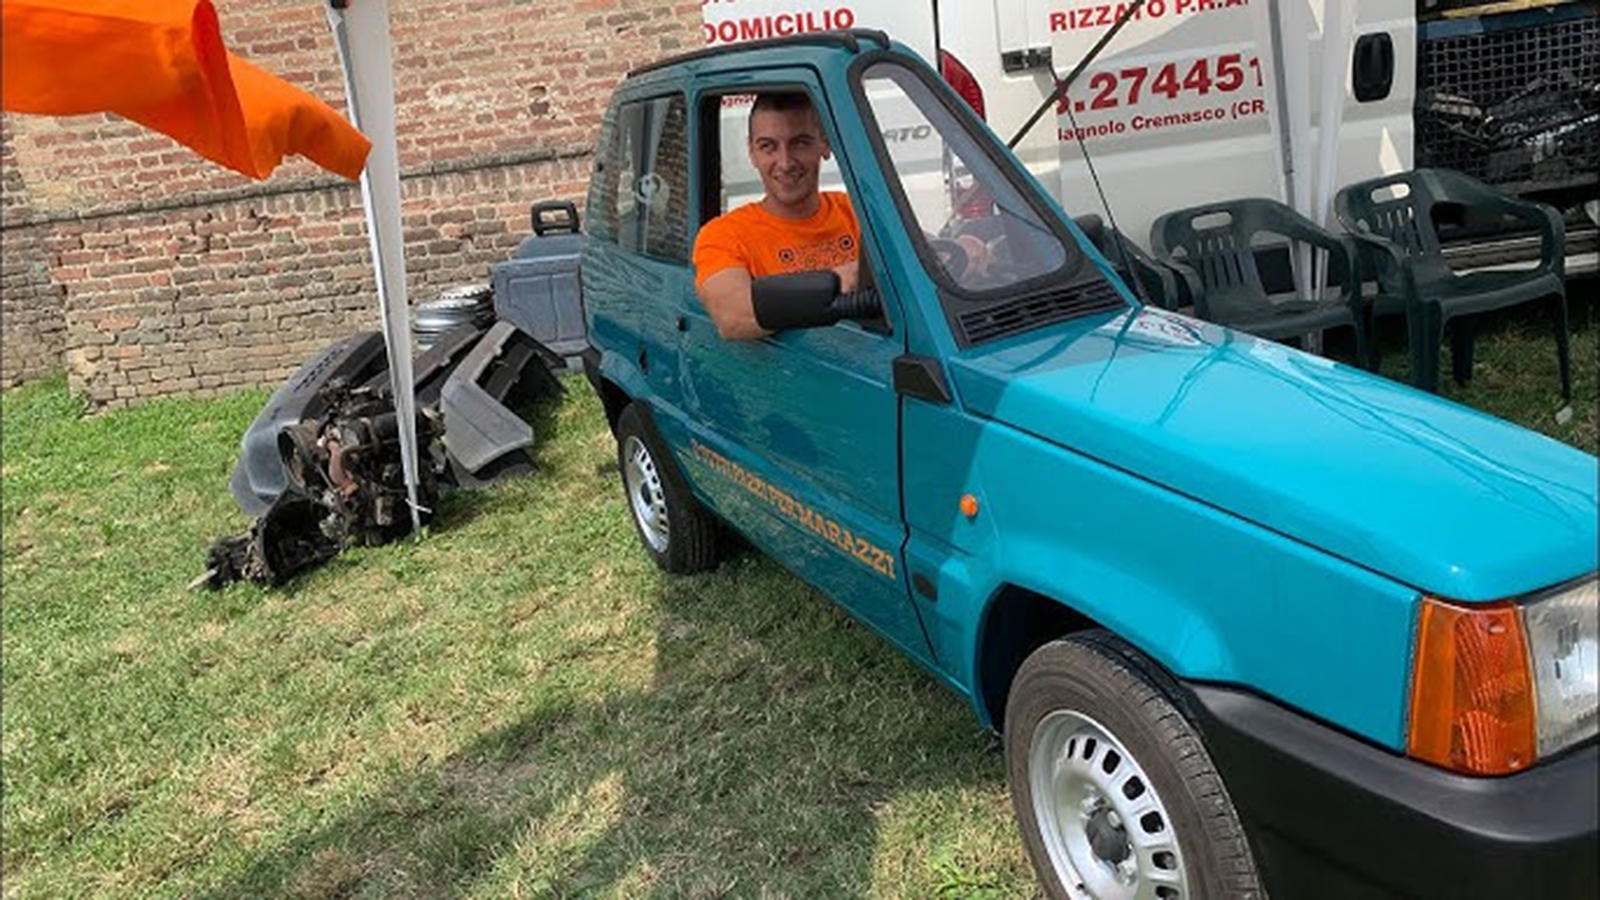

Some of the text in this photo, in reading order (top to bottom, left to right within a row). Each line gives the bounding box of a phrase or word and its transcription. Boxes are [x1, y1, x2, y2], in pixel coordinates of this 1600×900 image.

[703, 8, 854, 43] DOMICILIO
[1131, 107, 1225, 131] Cremasco
[1231, 99, 1269, 120] (CR
[796, 502, 897, 579] MARAZZI
